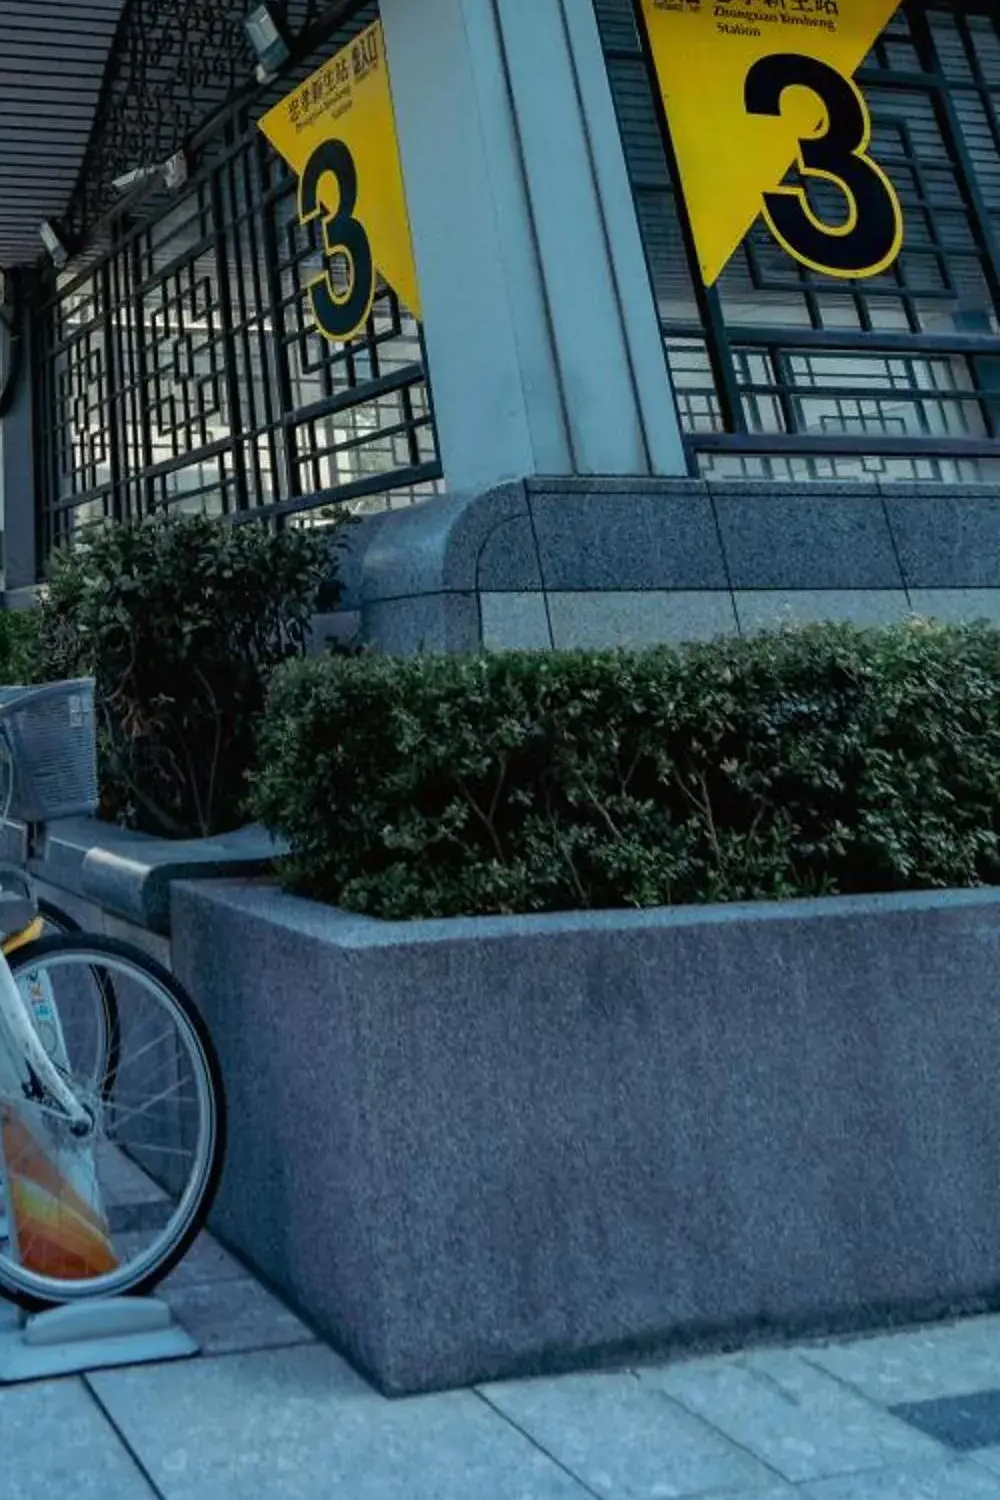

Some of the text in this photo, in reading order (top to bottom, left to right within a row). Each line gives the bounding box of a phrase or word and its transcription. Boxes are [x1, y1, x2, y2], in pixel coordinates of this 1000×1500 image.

[715, 22, 761, 37] Station
[299, 138, 376, 336] 3
[743, 52, 903, 272] 3
